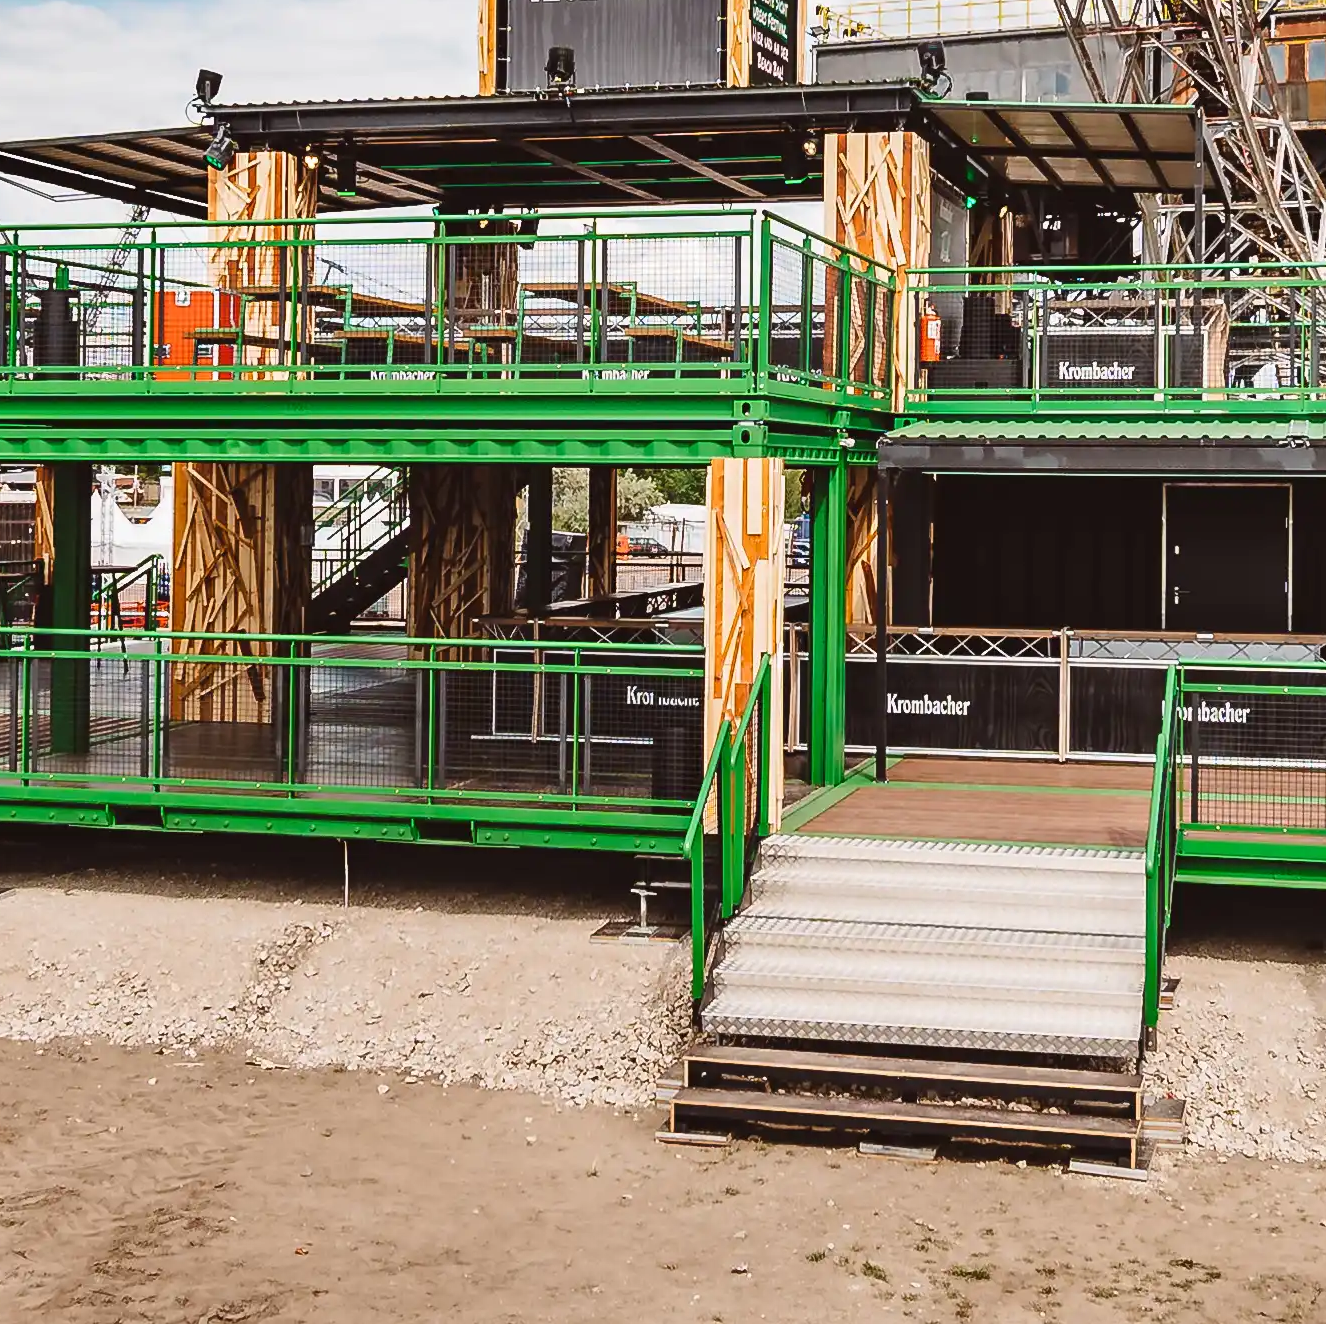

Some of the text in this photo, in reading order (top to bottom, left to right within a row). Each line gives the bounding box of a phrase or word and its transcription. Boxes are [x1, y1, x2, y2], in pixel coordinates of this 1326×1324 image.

[370, 370, 436, 381] Krmbacher
[1058, 361, 1135, 380] Krombacher
[886, 693, 971, 716] Krombacher
